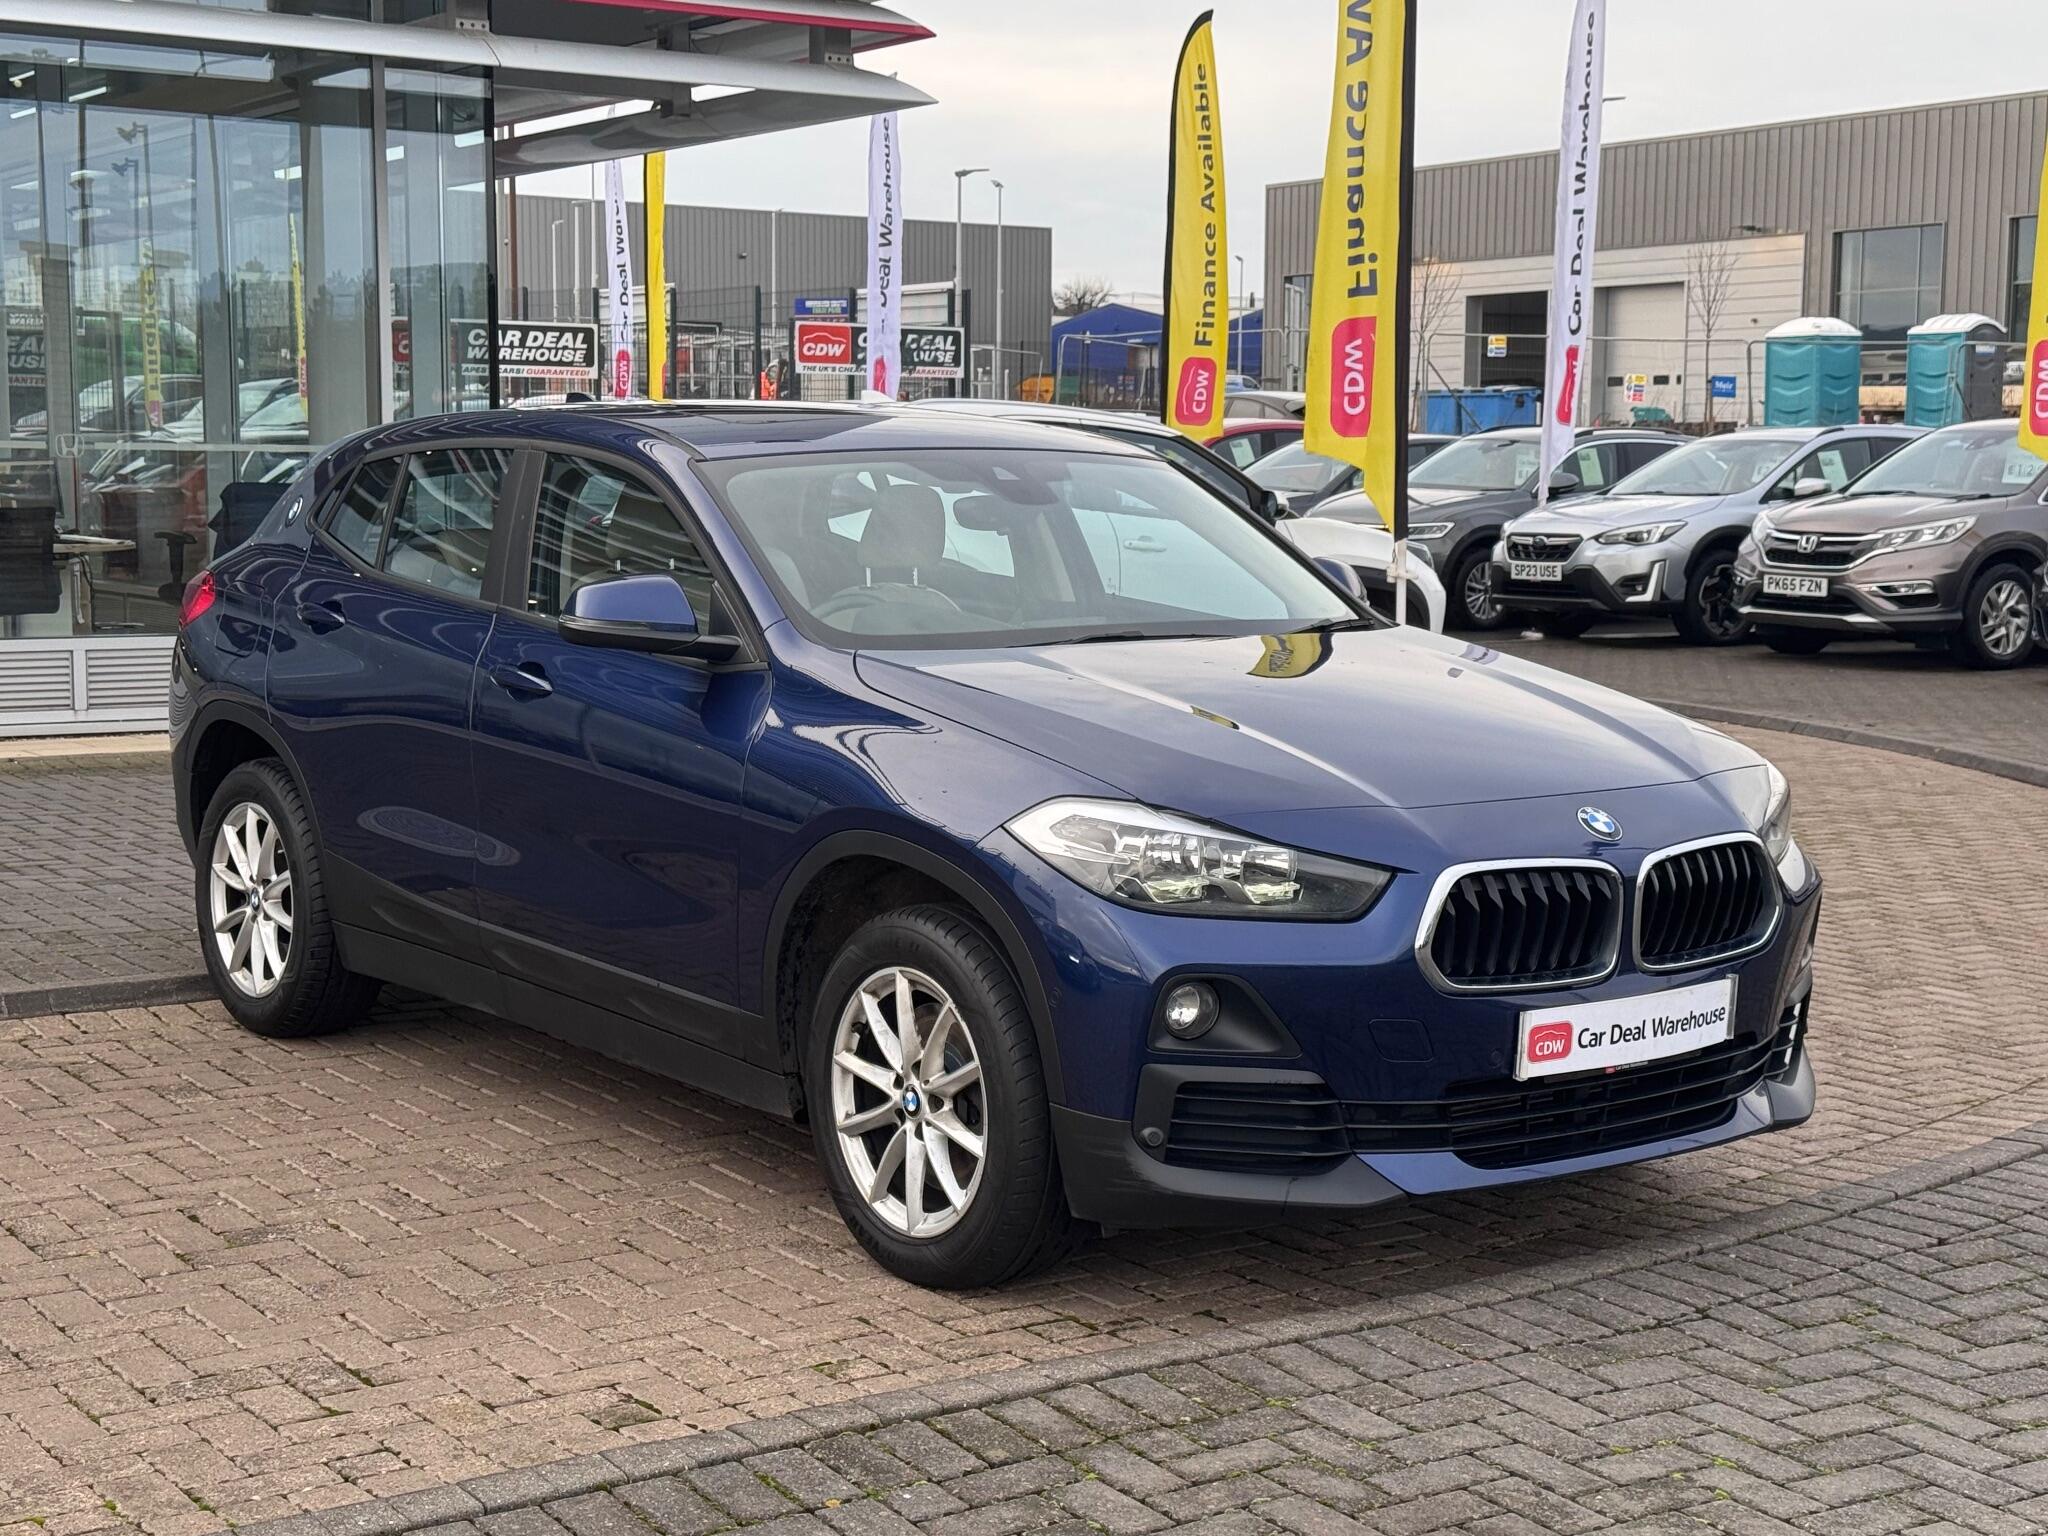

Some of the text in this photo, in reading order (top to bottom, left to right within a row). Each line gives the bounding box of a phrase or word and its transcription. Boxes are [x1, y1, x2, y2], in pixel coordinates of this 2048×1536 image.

[878, 116, 893, 248] Warehouse
[1194, 63, 1216, 347] Finance Available
[616, 262, 629, 308] Deal
[525, 330, 588, 349] DEAL
[467, 346, 587, 362] WREHOUSE
[802, 343, 847, 357] CDW
[526, 368, 590, 377] GUARANTEED!
[1192, 369, 1210, 414] CDW
[1514, 564, 1558, 578] SP23 USE
[1767, 576, 1822, 593] PK65 FZN
[1577, 1006, 1726, 1049] Car Deal Warehouse
[1535, 1039, 1565, 1056] CDW
